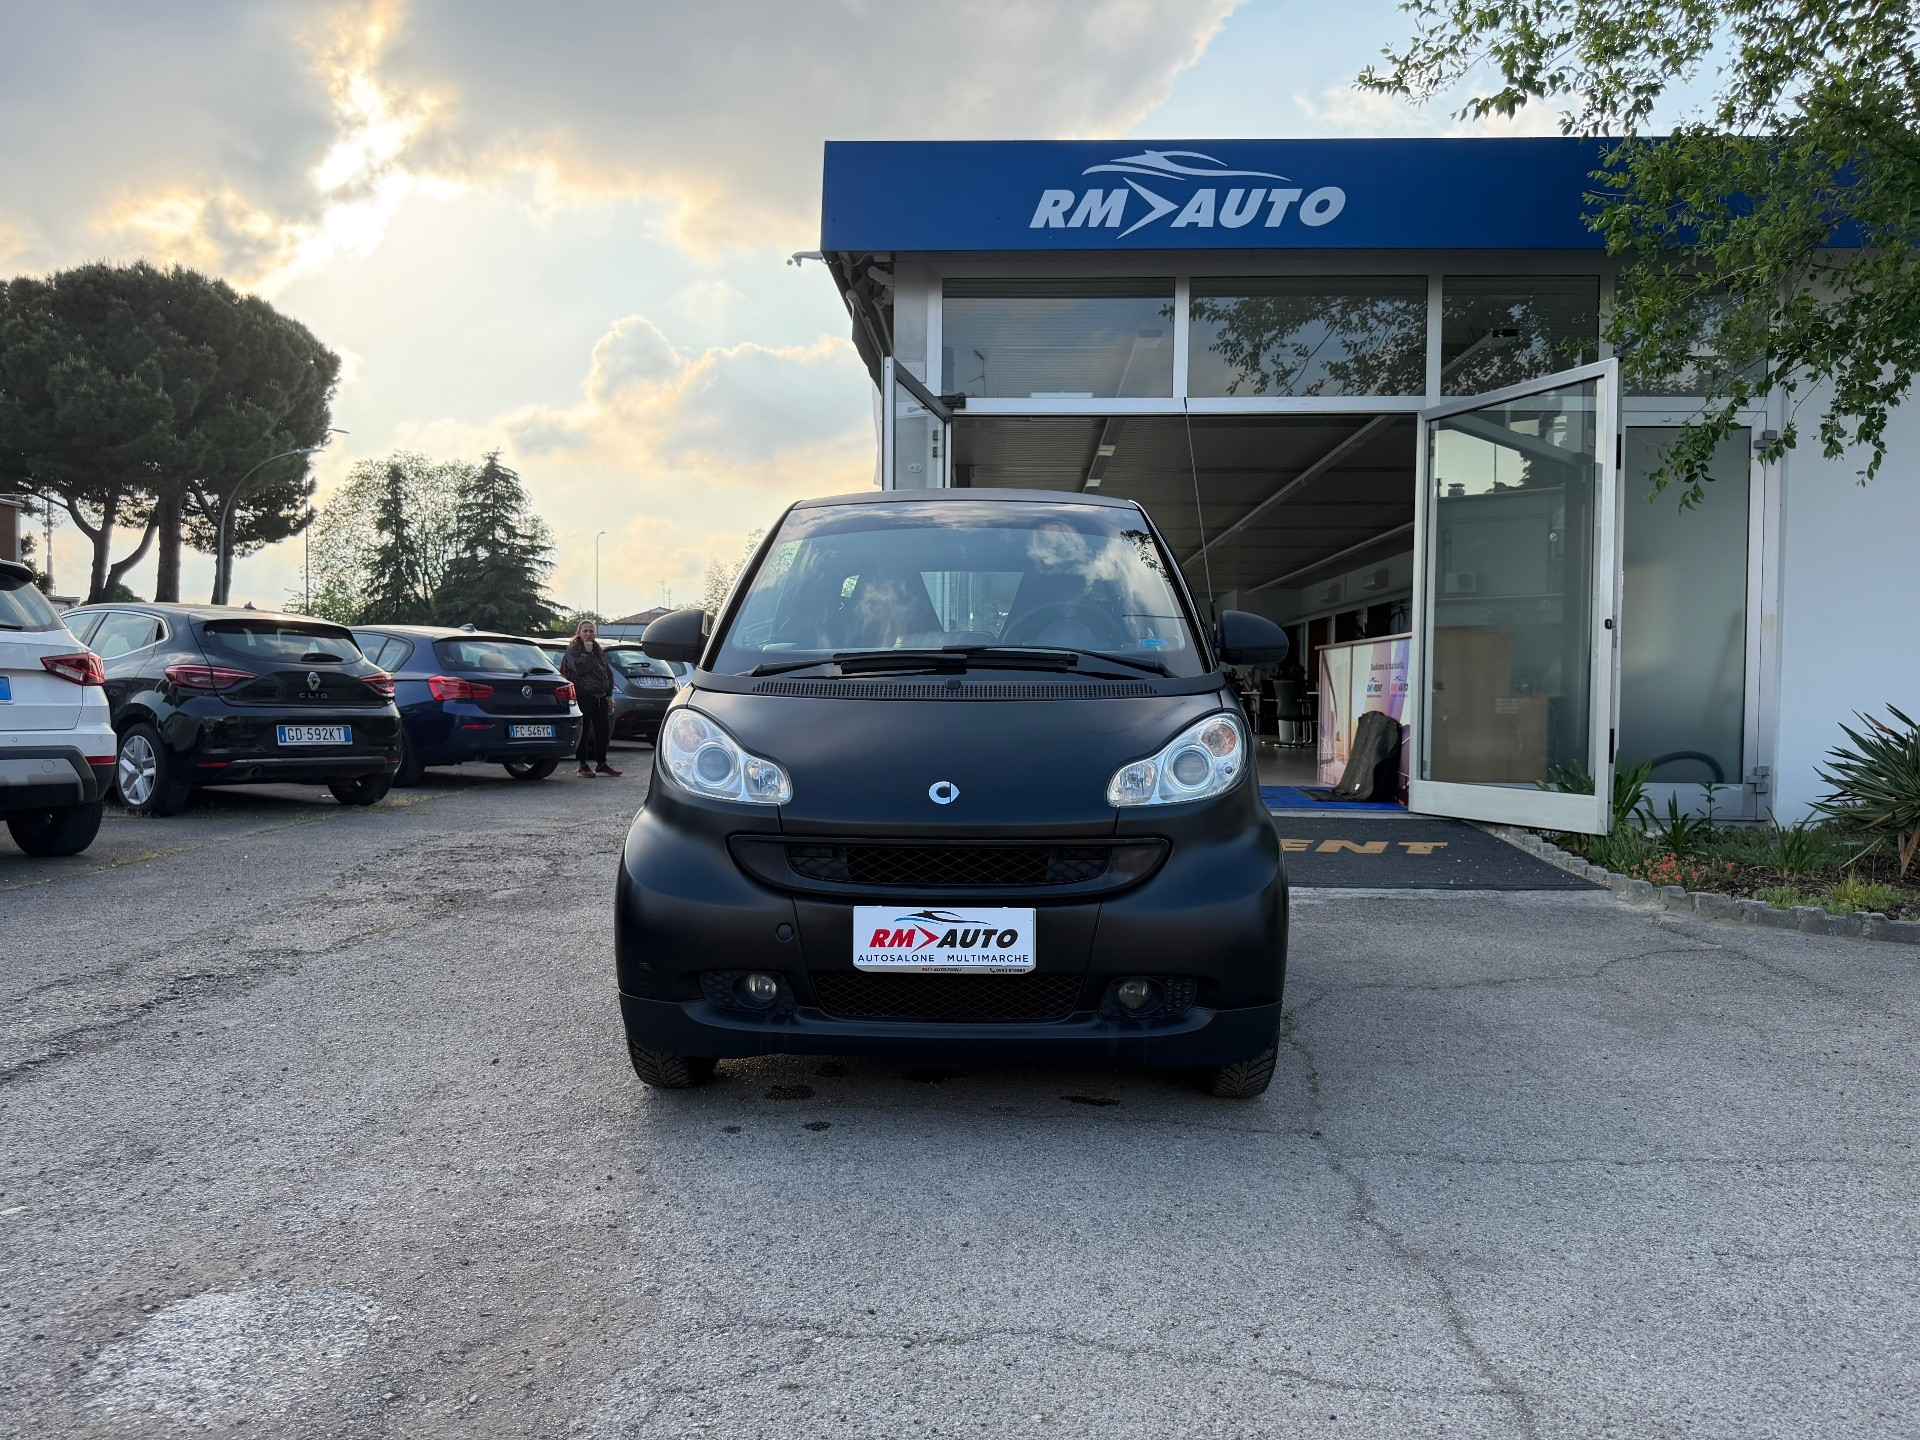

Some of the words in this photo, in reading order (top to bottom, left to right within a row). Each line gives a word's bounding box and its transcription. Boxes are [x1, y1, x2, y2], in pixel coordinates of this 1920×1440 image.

[1029, 189, 1129, 228] RM
[1169, 186, 1346, 229] AUTO
[1280, 838, 1448, 855] ENT
[869, 929, 916, 948] RM
[936, 928, 1018, 949] AUTO
[857, 954, 935, 963] AUTOSALONE
[947, 954, 1029, 963] MULTIMARCHE
